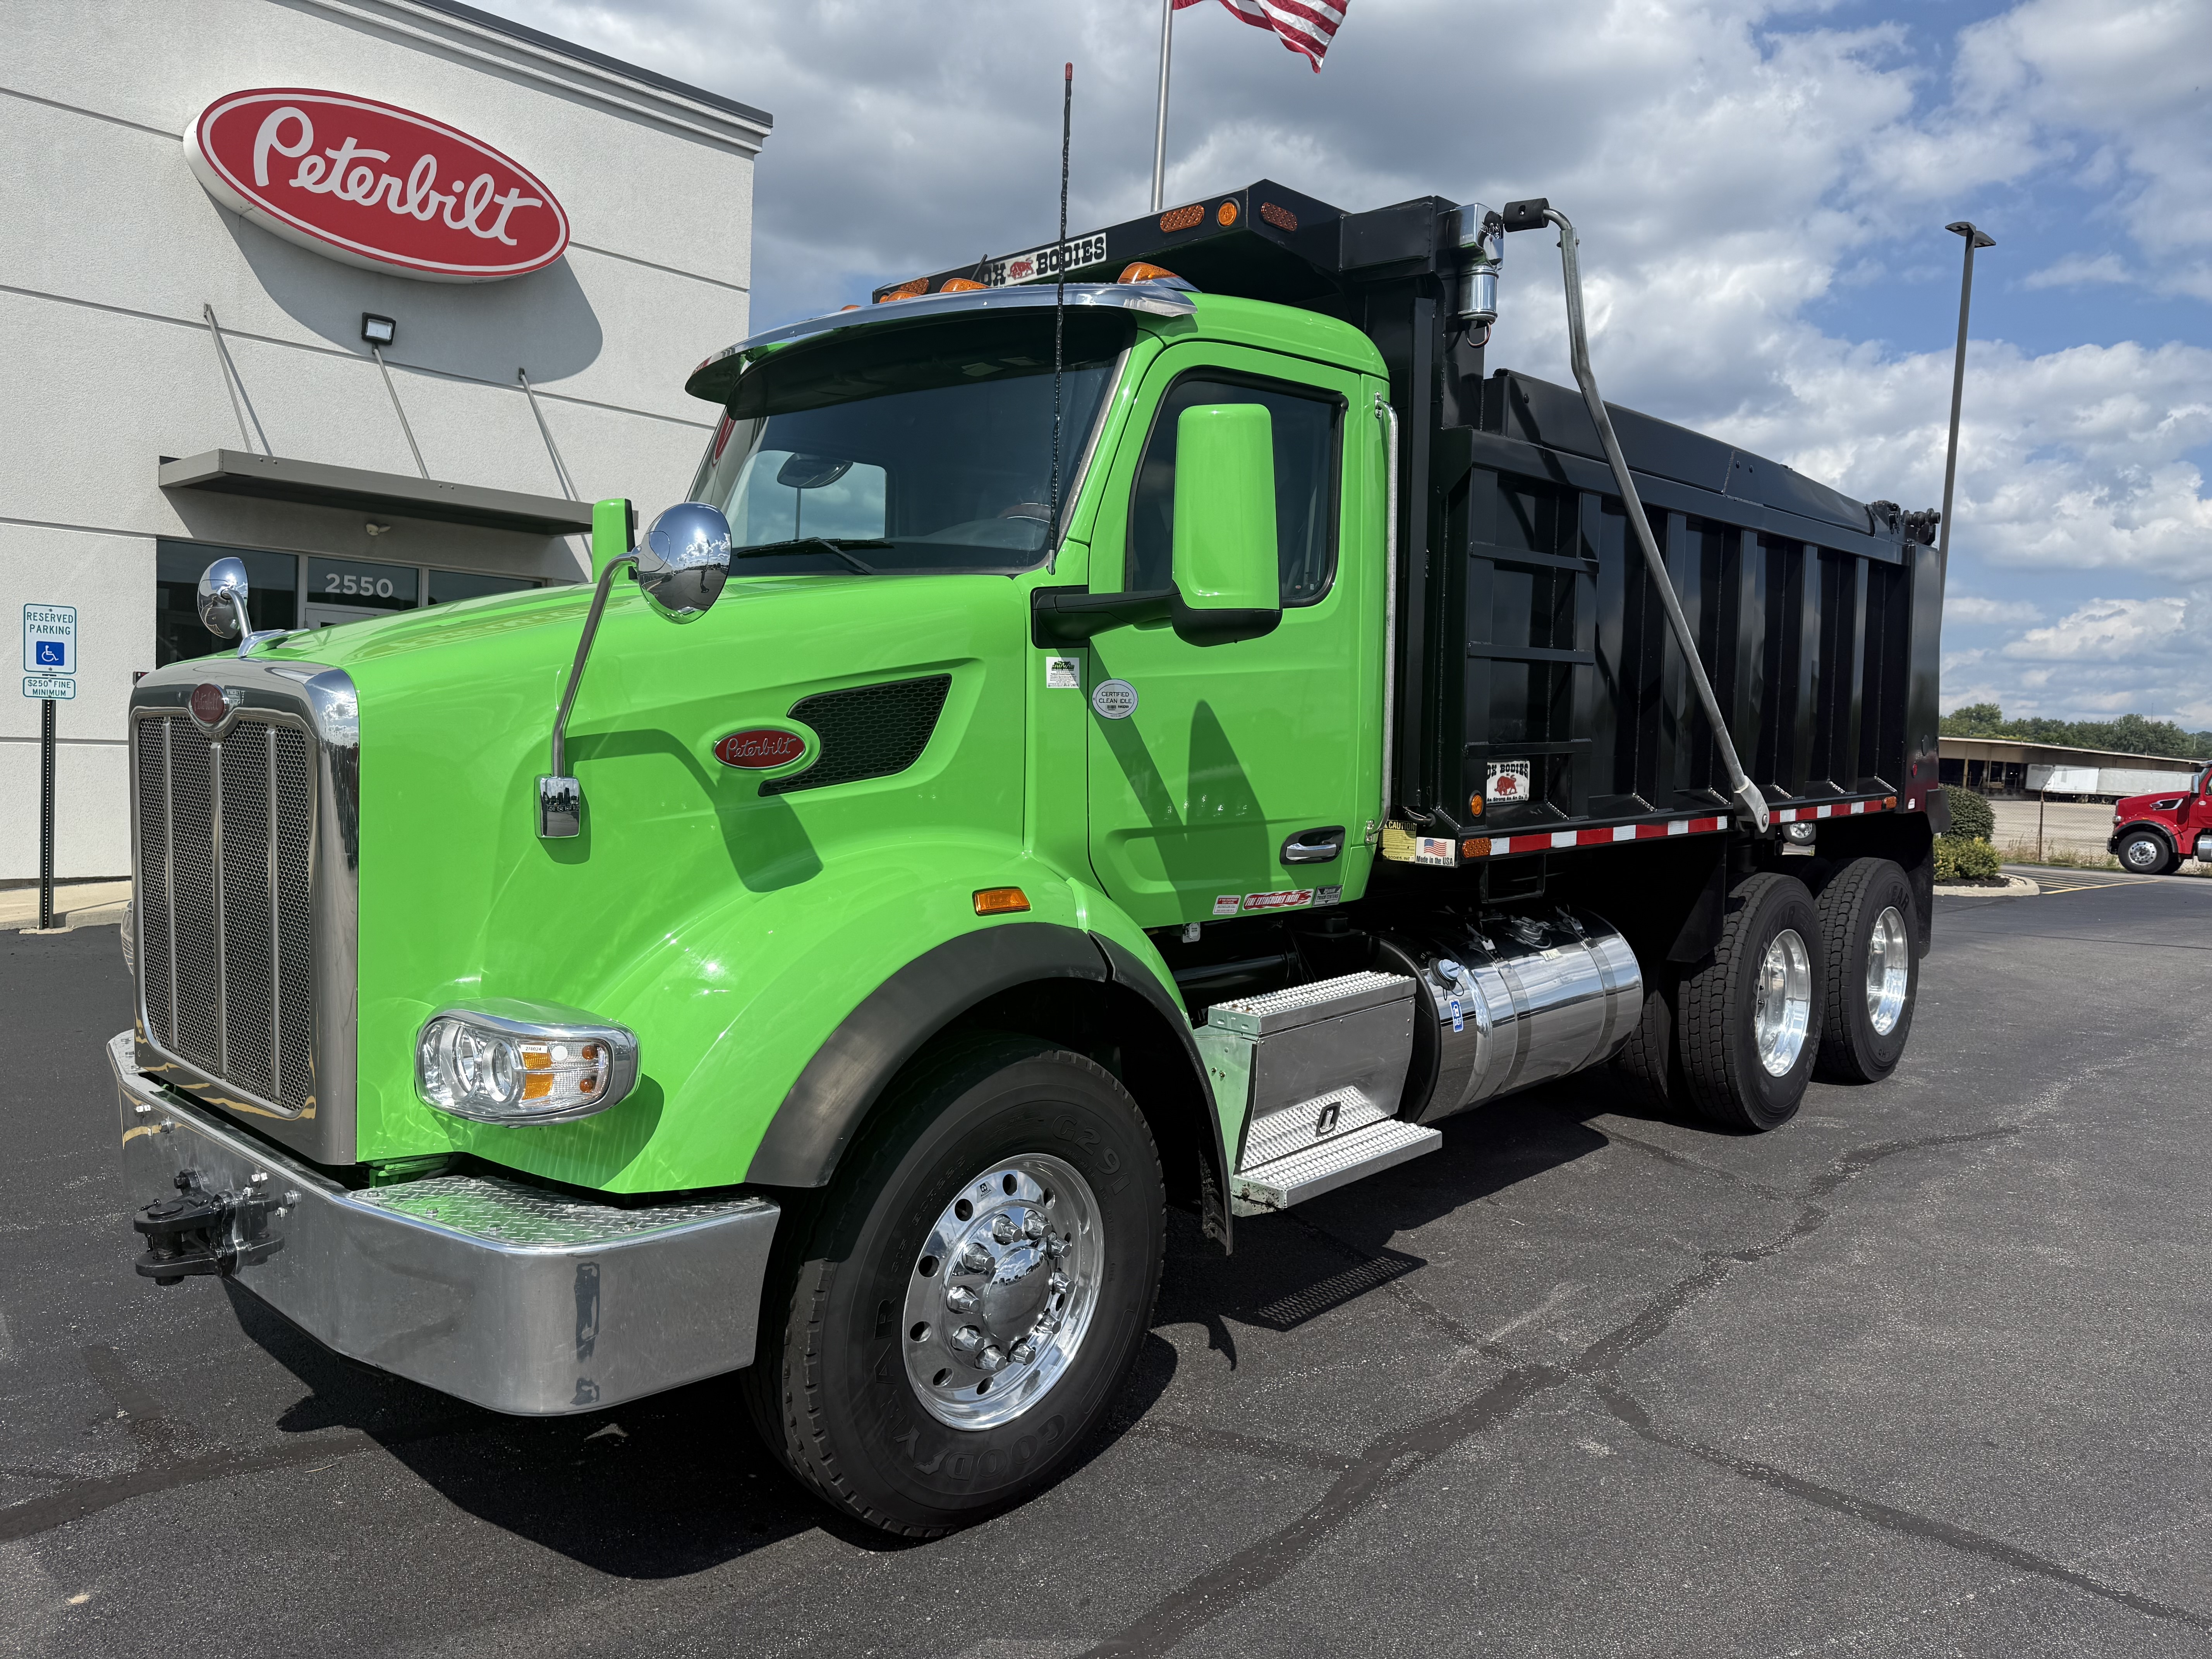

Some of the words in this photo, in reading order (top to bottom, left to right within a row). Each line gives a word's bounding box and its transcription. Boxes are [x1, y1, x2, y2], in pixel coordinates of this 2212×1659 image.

[254, 106, 543, 246] Peterbilt
[1036, 237, 1104, 275] BODIES
[325, 574, 393, 598] 2550
[26, 612, 74, 623] RESERVED
[29, 624, 70, 635] PARKING
[194, 691, 221, 711] Peterbilt
[726, 737, 796, 761] Peterbilt
[1500, 763, 1528, 780] BODIES
[1389, 821, 1415, 830] CAUTION
[1443, 857, 1453, 866] USA
[1245, 897, 1257, 906] FIRE
[1051, 1115, 1131, 1195] G291
[981, 1189, 992, 1197] ALCOA
[874, 1297, 1066, 1481] GOODYEAR
